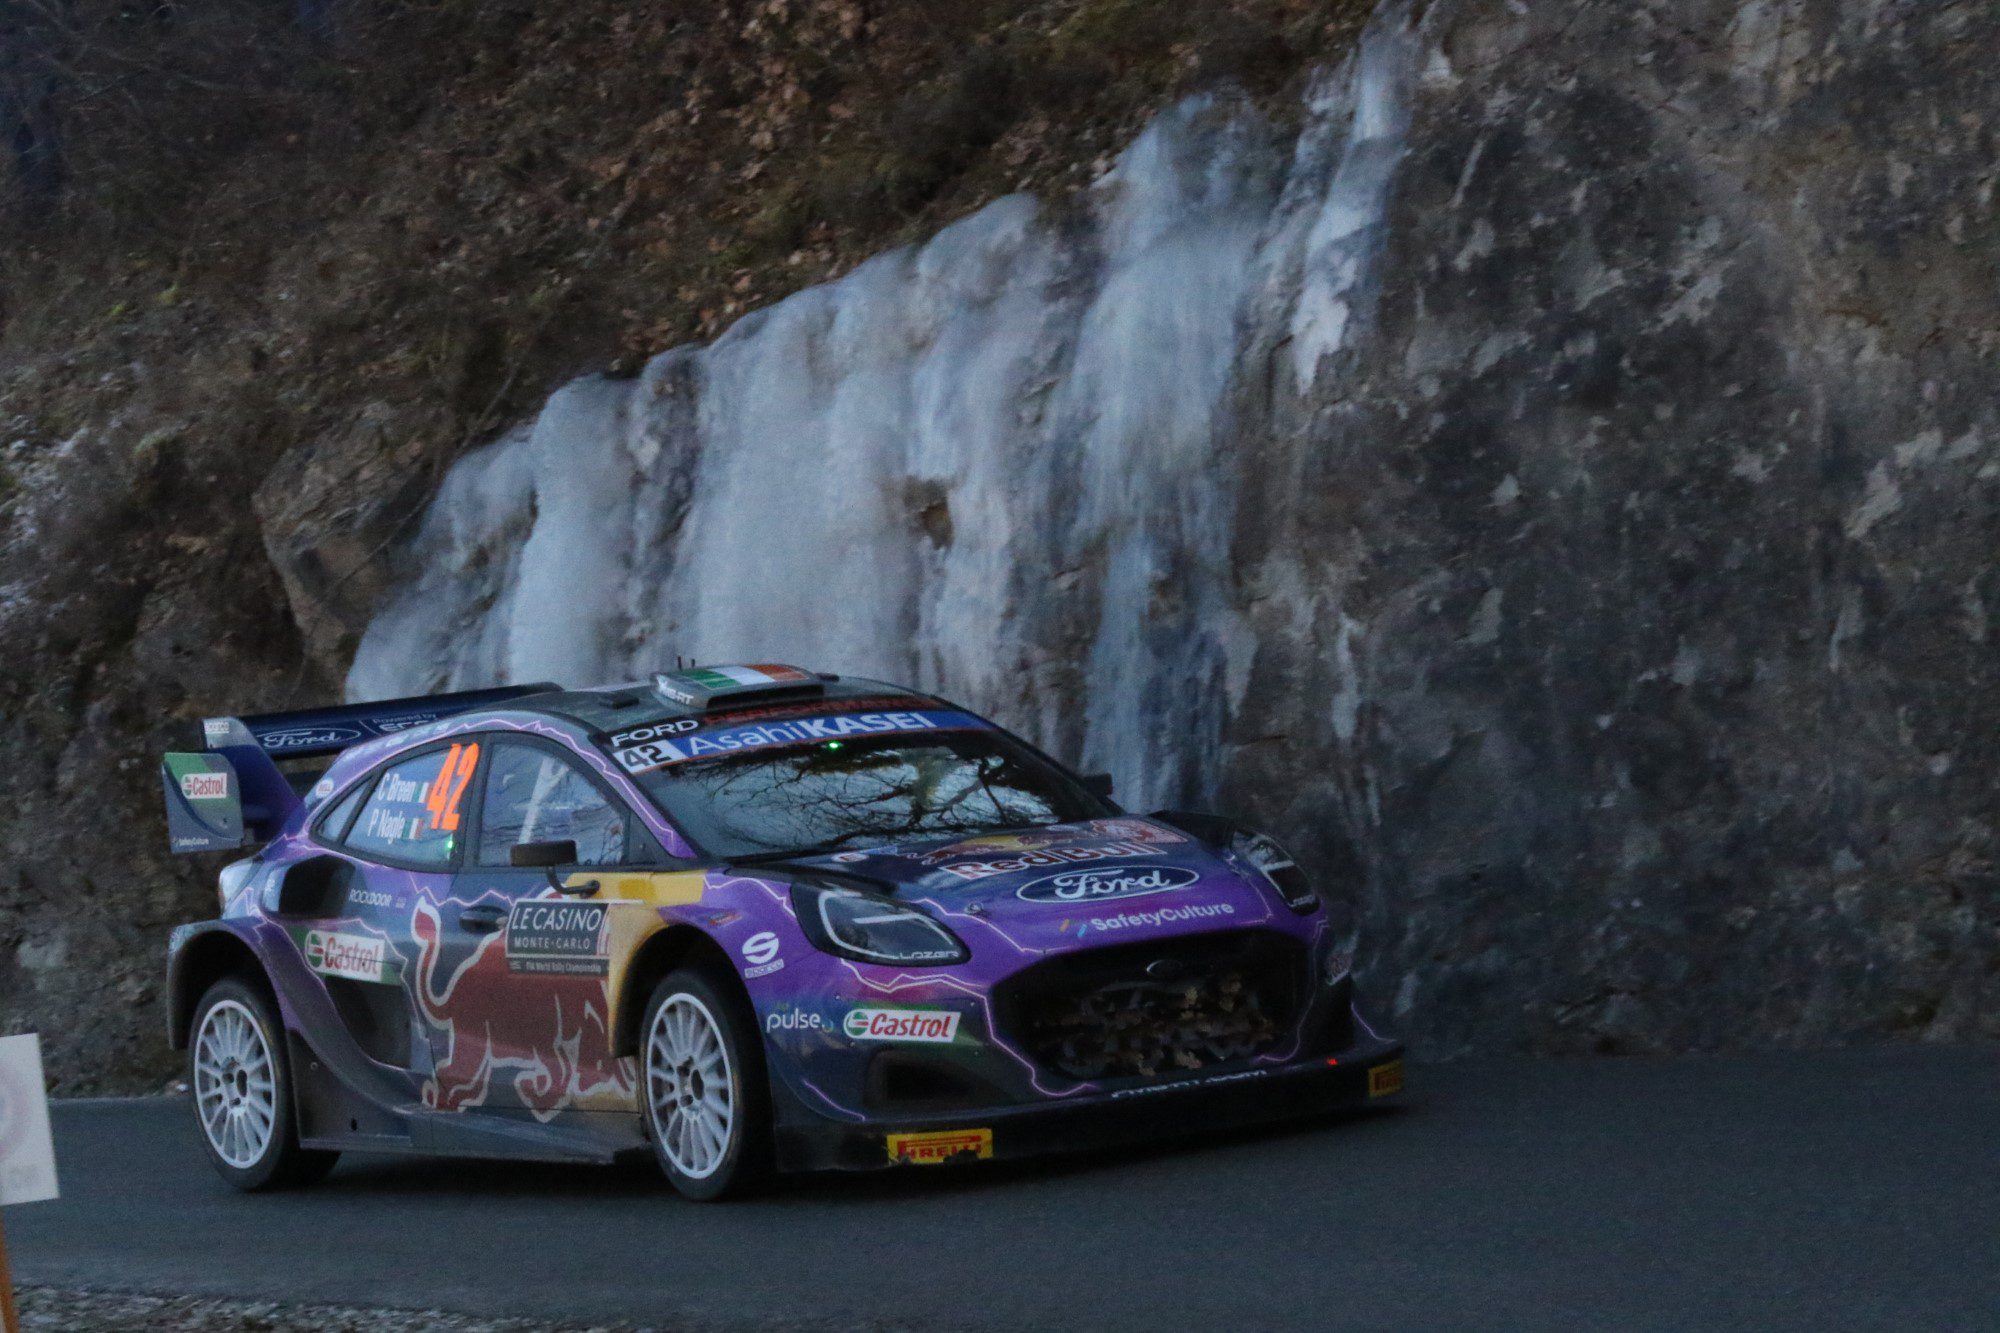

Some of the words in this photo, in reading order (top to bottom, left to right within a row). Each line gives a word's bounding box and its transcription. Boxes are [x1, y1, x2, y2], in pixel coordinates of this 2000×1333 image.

[263, 730, 341, 748] Ford
[611, 720, 699, 747] FORD
[622, 745, 672, 767] 42
[192, 777, 225, 796] Castrol
[378, 773, 390, 801] C
[427, 742, 479, 830] 42
[367, 809, 379, 837] P
[377, 809, 406, 844] Nagle
[1054, 867, 1170, 899] Ford
[511, 908, 532, 930] LE
[532, 908, 602, 931] CASINO
[1090, 900, 1235, 933] SafetyCulture
[324, 936, 379, 974] Castrol
[766, 1008, 821, 1034] pulse
[870, 1013, 951, 1038] Castrol
